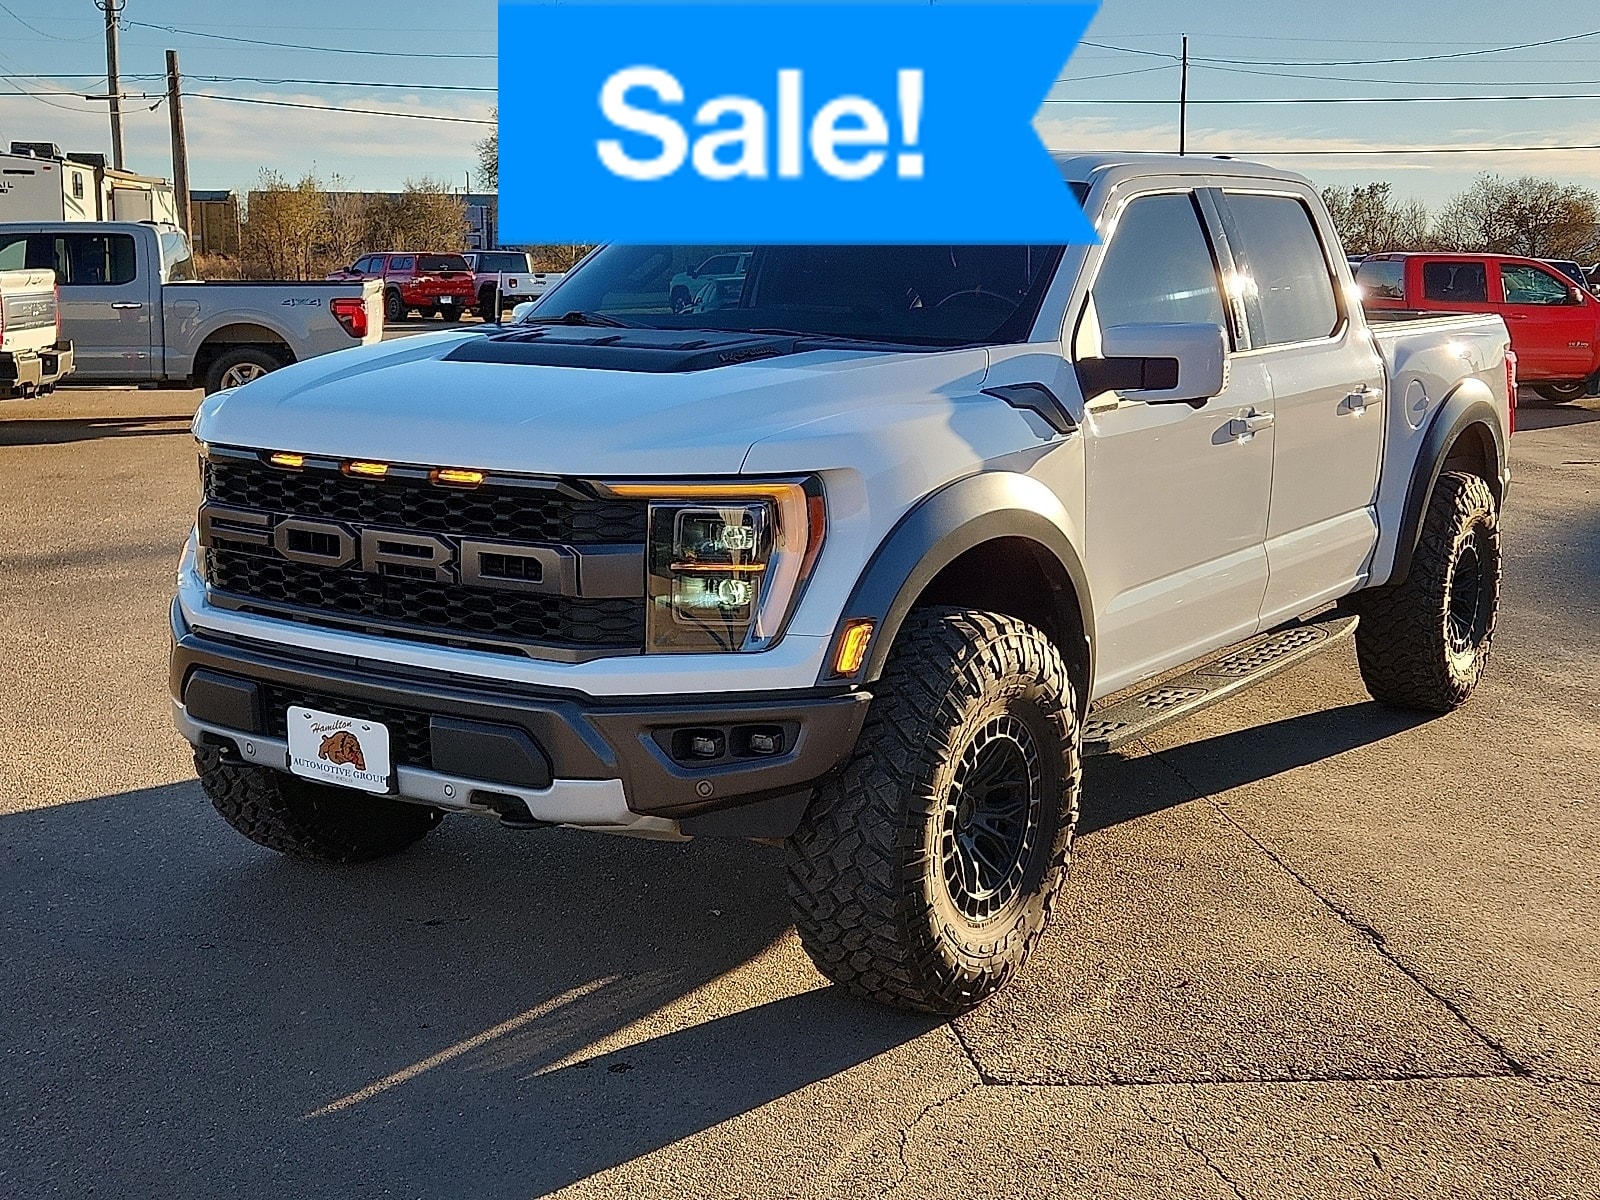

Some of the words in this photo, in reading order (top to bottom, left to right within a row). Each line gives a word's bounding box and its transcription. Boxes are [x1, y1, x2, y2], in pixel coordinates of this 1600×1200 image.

[199, 500, 582, 598] FORD
[311, 720, 352, 734] Hamilton
[293, 757, 351, 777] AUTOMOTIVE
[353, 770, 386, 783] GROUP
